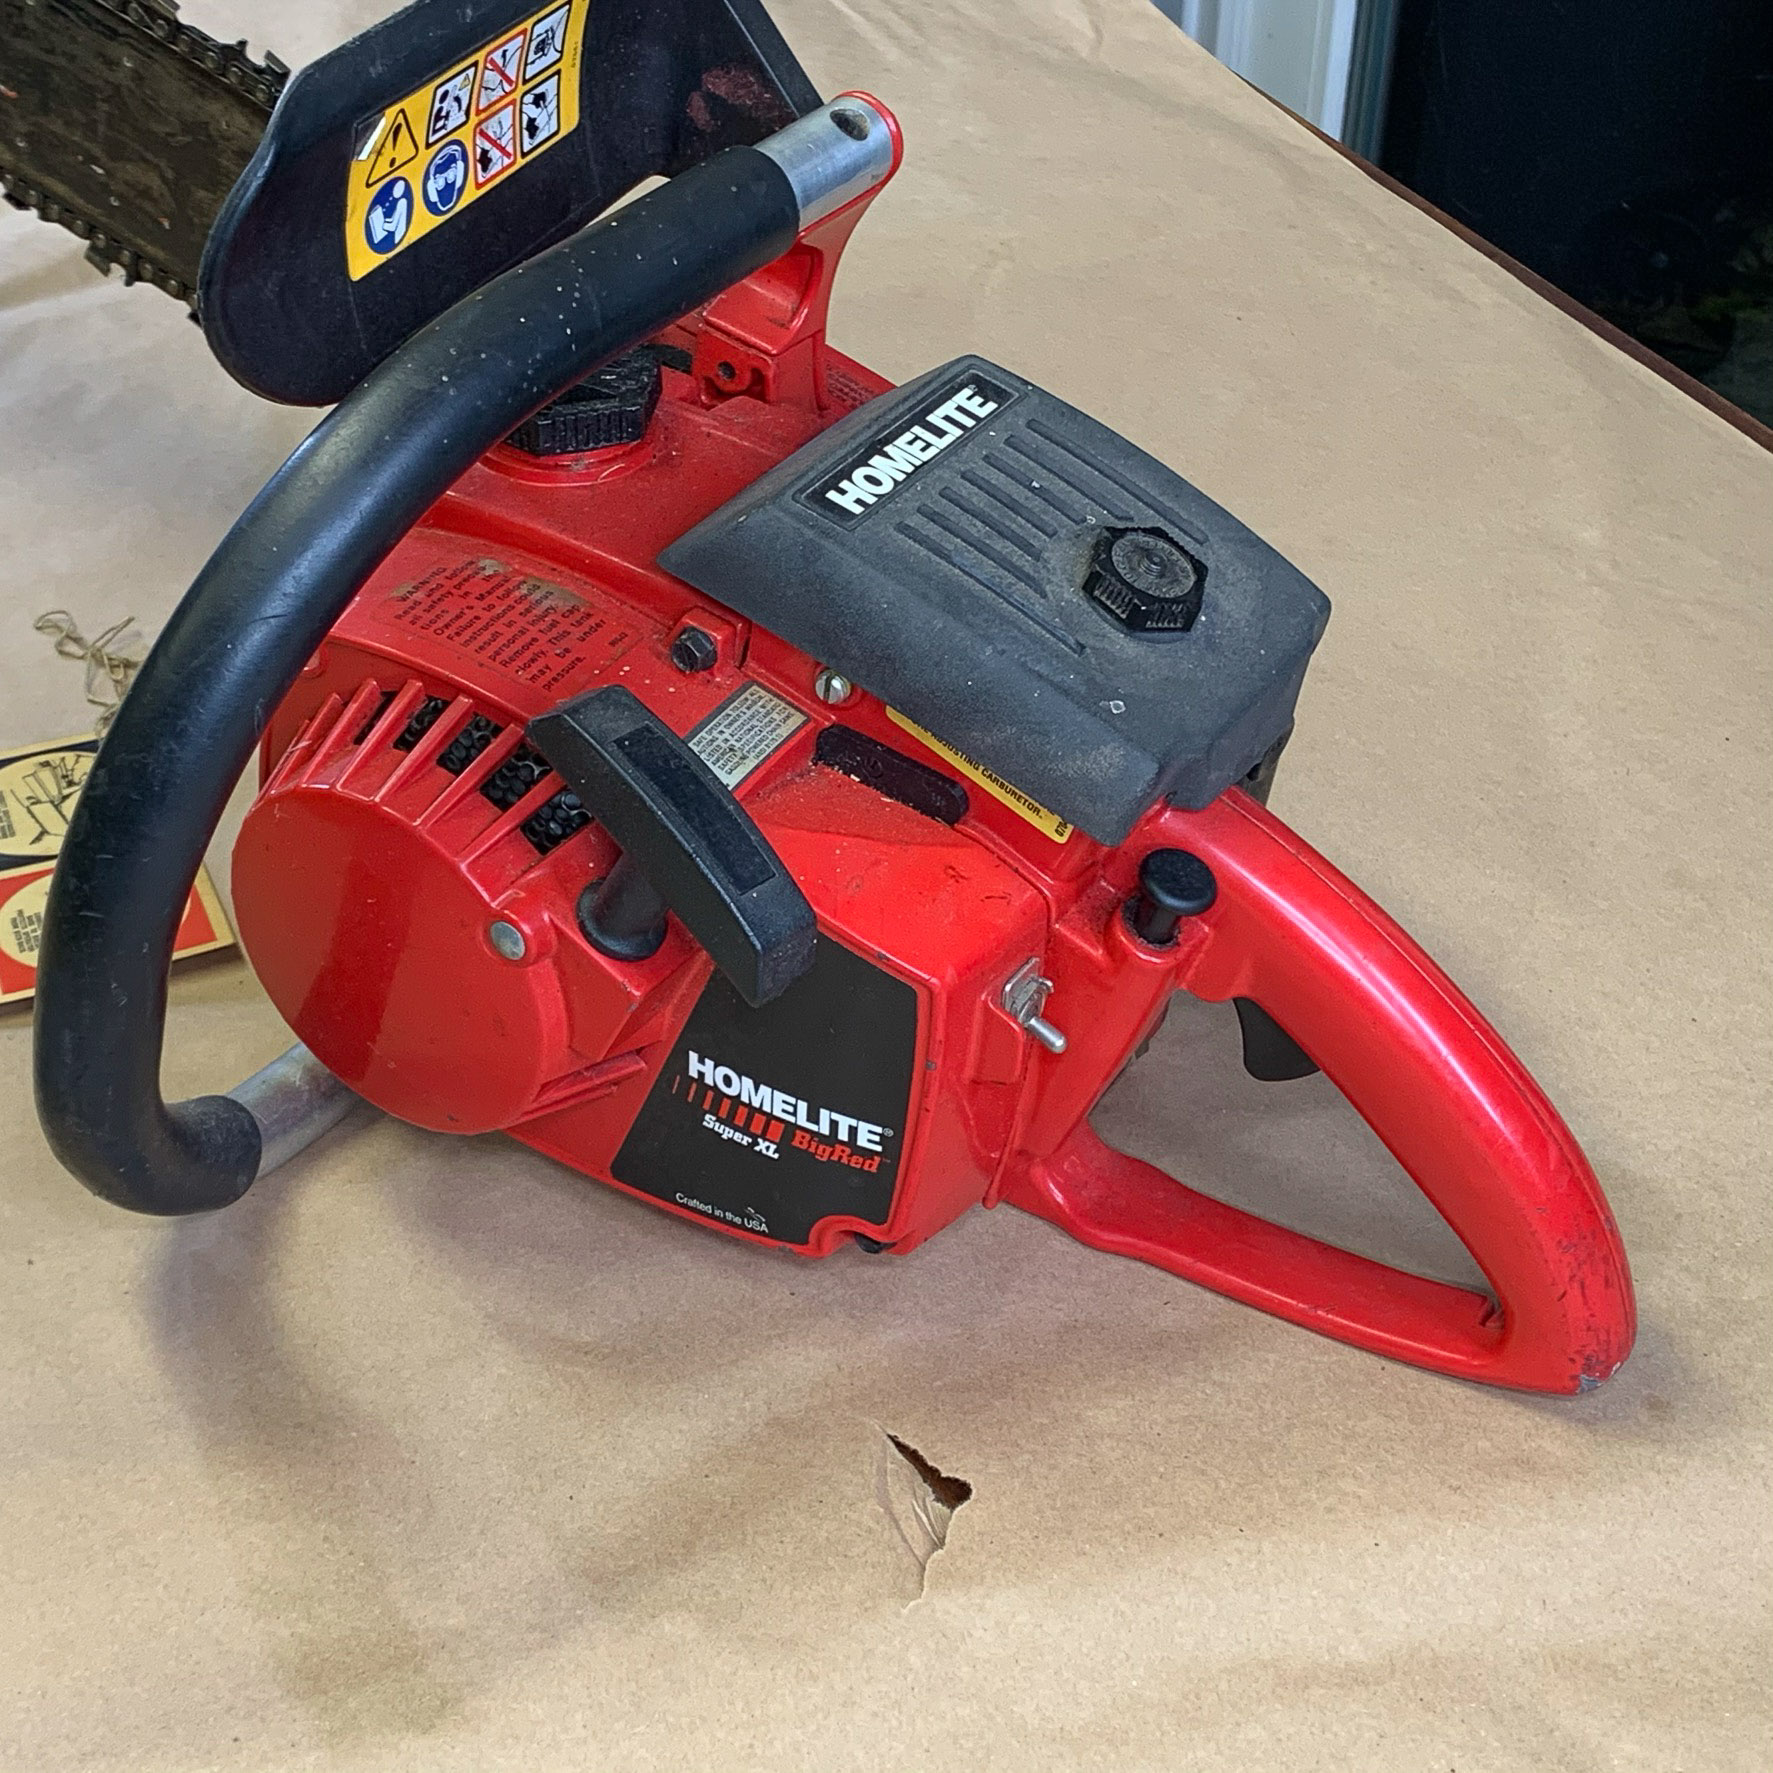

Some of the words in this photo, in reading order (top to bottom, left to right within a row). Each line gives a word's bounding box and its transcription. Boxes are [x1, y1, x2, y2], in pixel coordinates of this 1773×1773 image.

[825, 387, 998, 515] HOMELITE
[420, 589, 455, 615] safety
[457, 589, 472, 599] in
[458, 603, 516, 647] instructions
[512, 583, 541, 605] could
[431, 603, 474, 636] Owner's
[445, 613, 482, 641] Failure
[481, 602, 497, 612] to
[472, 630, 504, 653] result
[501, 618, 517, 628] in
[516, 589, 554, 617] serious
[498, 635, 540, 667] Remove
[537, 618, 561, 635] fuel
[559, 603, 583, 620] cap
[546, 628, 571, 646] This
[569, 610, 594, 628] tank
[485, 626, 531, 661] personal
[526, 664, 554, 684] may
[553, 645, 573, 659] be
[575, 618, 607, 642] under
[540, 654, 589, 691] pressure.
[688, 1050, 882, 1152] HOMELITE
[702, 1114, 752, 1147] Super
[753, 1138, 779, 1159] XL
[791, 1129, 881, 1173] BigRed
[675, 1192, 712, 1215] Crafted
[714, 1204, 724, 1217] in
[725, 1208, 742, 1225] the
[744, 1218, 769, 1234] USA
